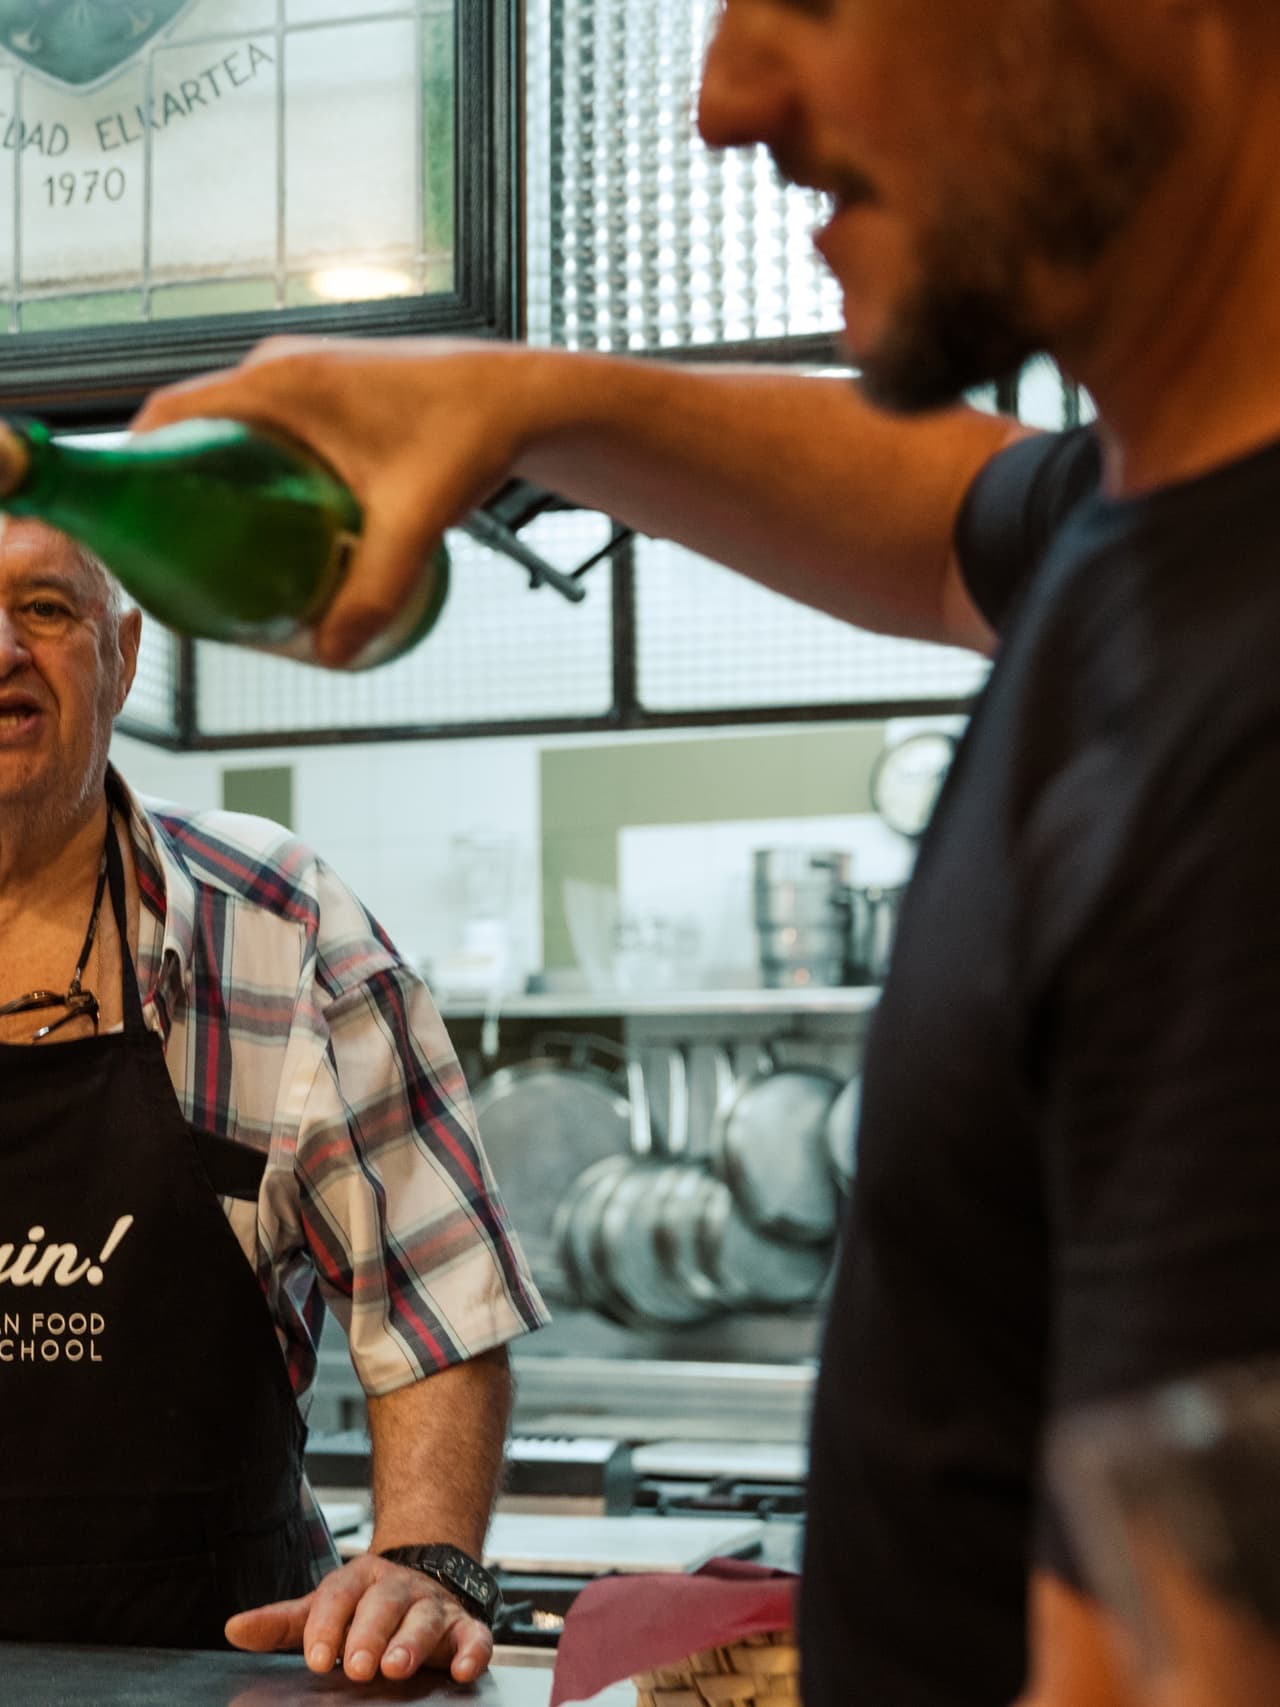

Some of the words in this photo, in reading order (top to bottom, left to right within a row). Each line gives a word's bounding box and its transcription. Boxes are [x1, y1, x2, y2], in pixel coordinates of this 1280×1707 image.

[95, 43, 274, 152] ELKARTEA
[42, 167, 126, 207] 1970
[32, 1312, 105, 1335] FOOD
